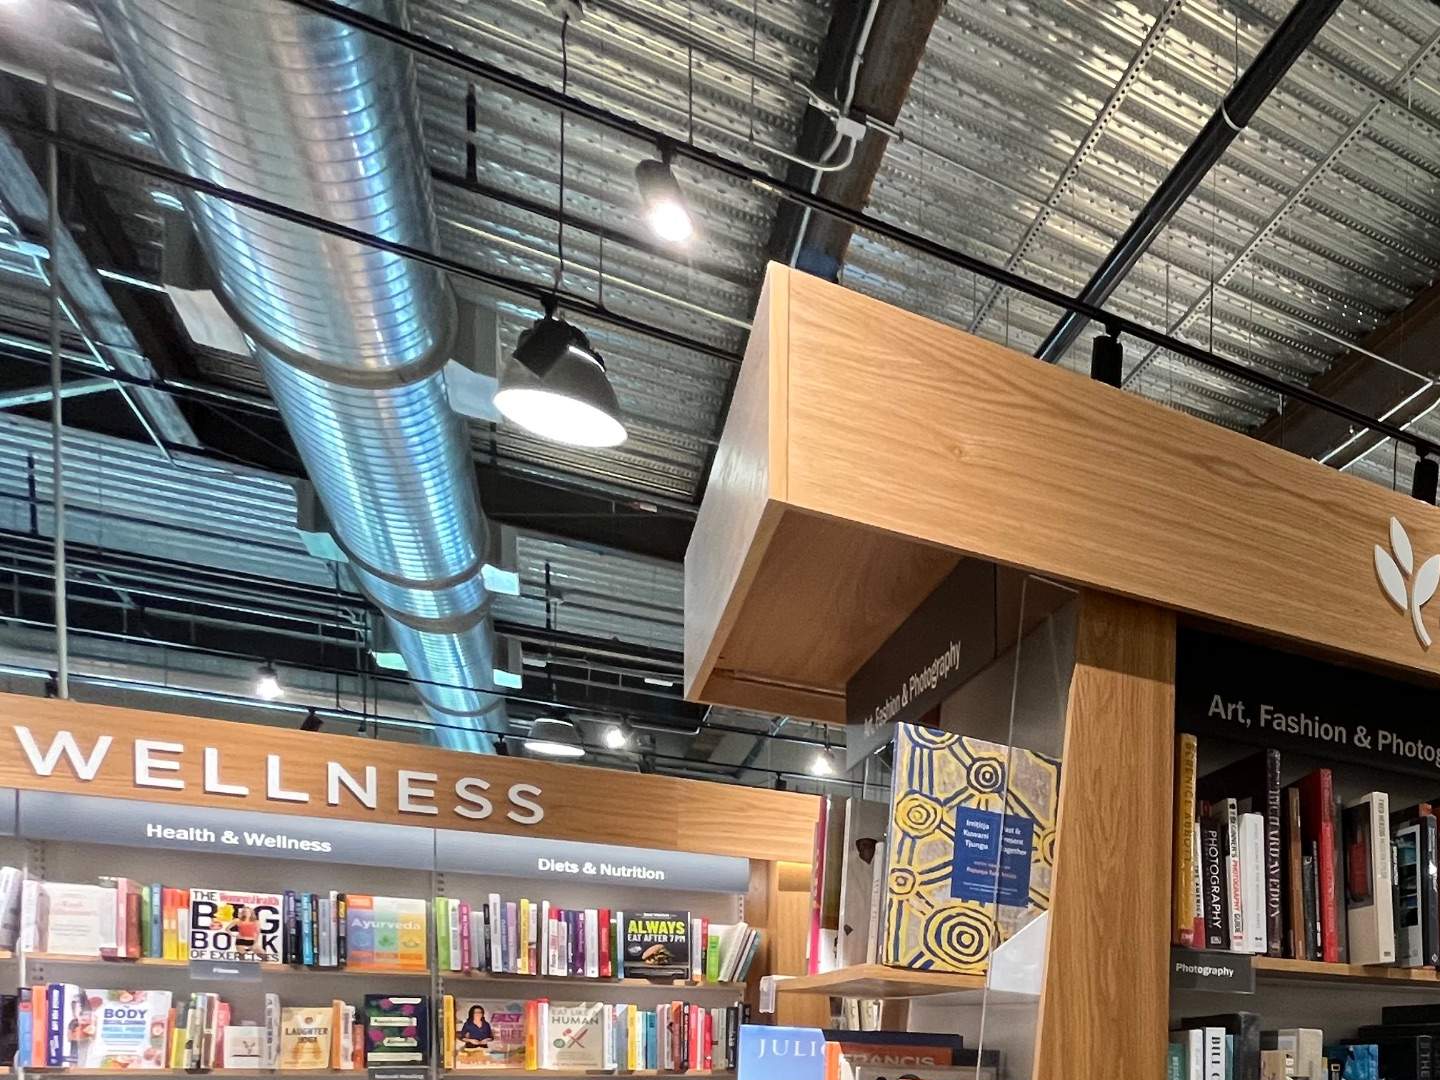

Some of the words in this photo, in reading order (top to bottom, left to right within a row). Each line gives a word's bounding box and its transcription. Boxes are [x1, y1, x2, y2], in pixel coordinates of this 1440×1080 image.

[901, 682, 909, 708] &
[909, 640, 961, 702] Photography
[1208, 693, 1251, 728] Art,
[1259, 703, 1348, 745] Fashion
[1352, 726, 1373, 750] &
[12, 725, 546, 827] WELLNESS
[146, 823, 217, 844] Health
[220, 829, 240, 846] &
[242, 831, 333, 854] Wellness
[537, 857, 580, 875] Diets
[582, 862, 597, 876] &
[599, 863, 666, 881] Nutrition
[1207, 829, 1222, 930] PHOTOGRAPHY
[192, 890, 218, 902] THE
[1231, 859, 1242, 912] PHOTOGRAPHY
[1267, 861, 1281, 918] AVEDON
[351, 917, 422, 931] Ayurveda
[627, 919, 686, 936] ALWAYS
[1234, 913, 1243, 935] GUIDE
[190, 932, 279, 954] BOK
[627, 933, 645, 943] EAT
[646, 933, 668, 943] AFTER
[190, 950, 207, 960] OF
[1175, 962, 1235, 978] Photography
[103, 1008, 148, 1020] BODY
[551, 1015, 600, 1026] HUMAN
[1210, 1036, 1222, 1065] BILL
